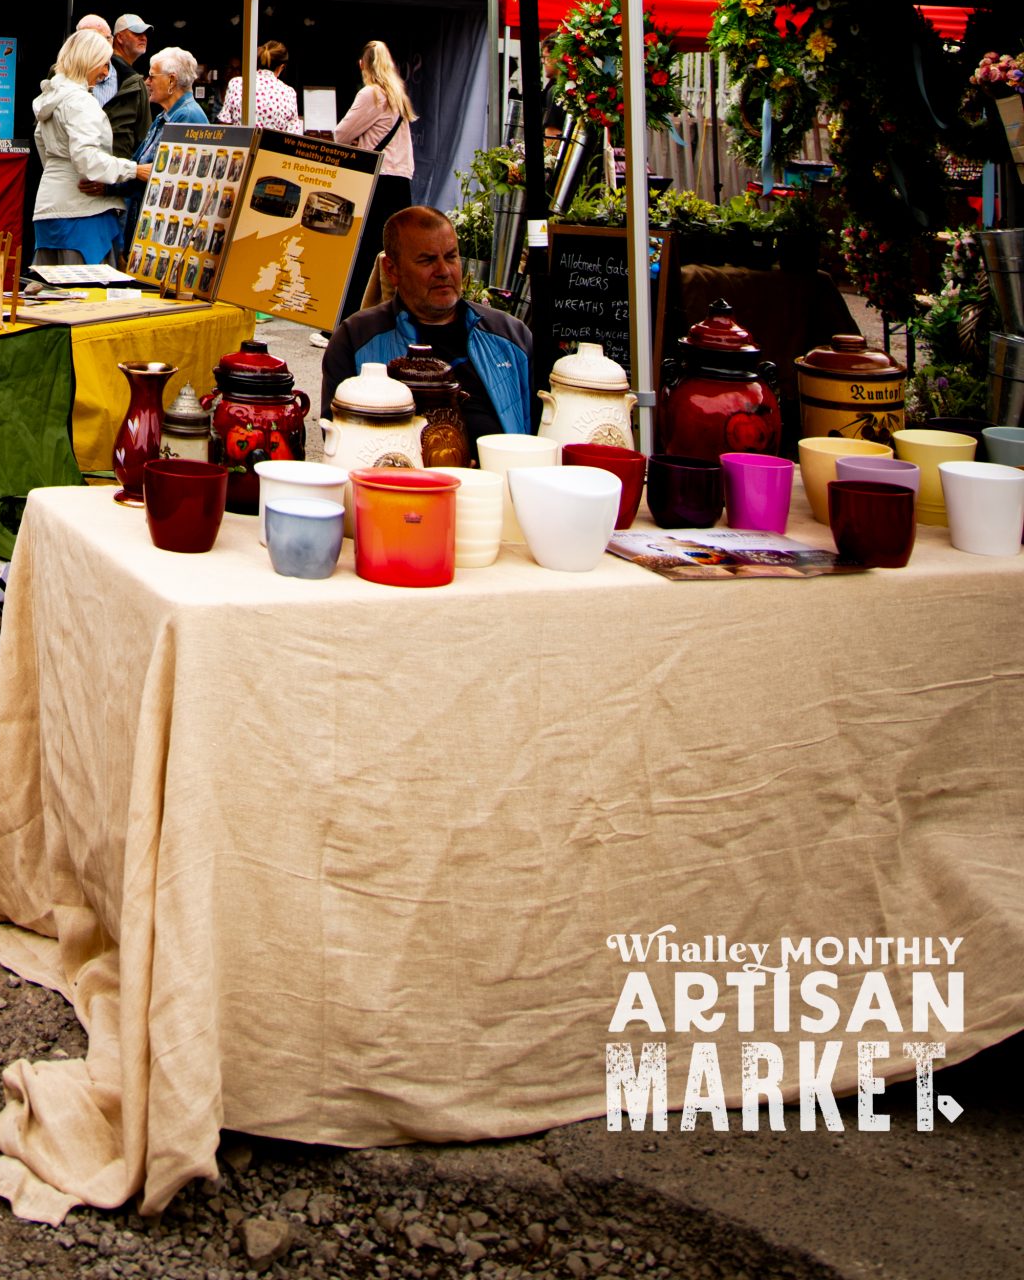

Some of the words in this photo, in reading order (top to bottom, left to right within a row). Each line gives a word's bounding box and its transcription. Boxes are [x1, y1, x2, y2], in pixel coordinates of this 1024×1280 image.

[190, 129, 198, 140] Dog
[204, 130, 213, 139] For
[213, 130, 224, 140] Life
[284, 137, 296, 146] We
[297, 140, 319, 151] Never
[320, 145, 350, 160] Destroy
[351, 152, 357, 160] A
[295, 148, 324, 163] Healthy
[325, 156, 341, 167] Dog
[281, 161, 291, 170] 21
[292, 161, 338, 179] Rehoming
[297, 174, 333, 189] Centres
[559, 253, 603, 275] Allotment
[568, 271, 609, 291] FLOWERS
[554, 298, 604, 316] WREATHS
[614, 308, 629, 321] £2
[552, 322, 591, 337] FLOWER
[595, 326, 629, 340] BUNCHE
[850, 382, 902, 400] Rumtopf
